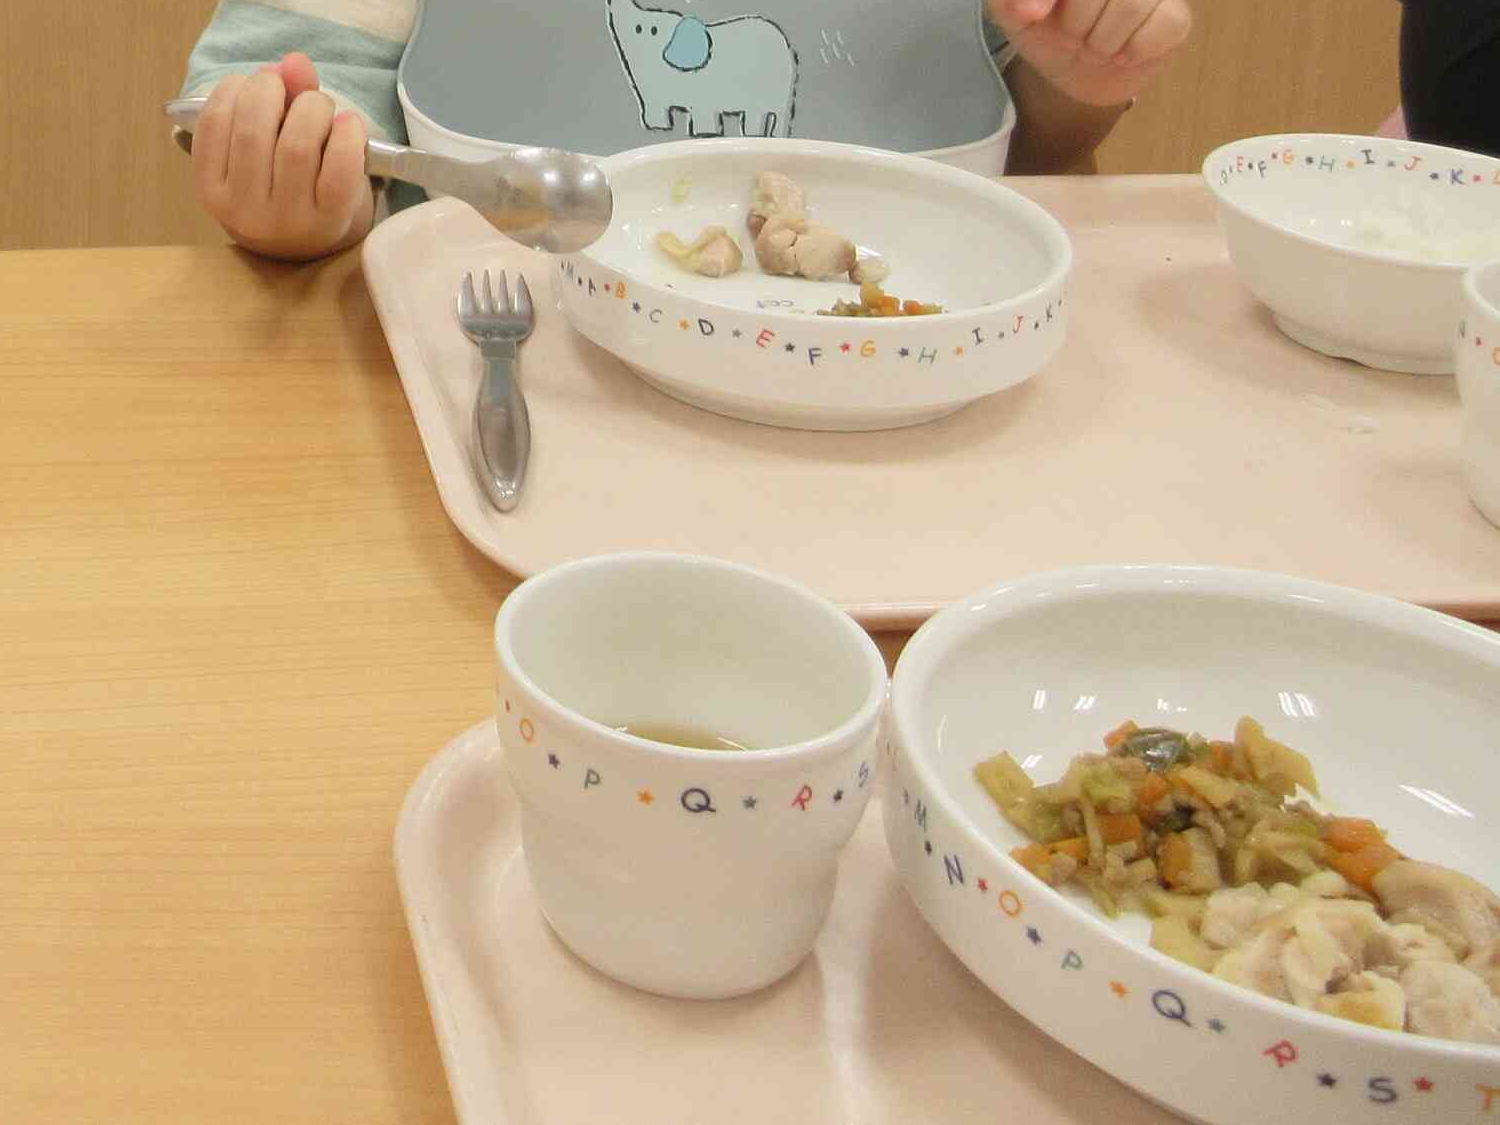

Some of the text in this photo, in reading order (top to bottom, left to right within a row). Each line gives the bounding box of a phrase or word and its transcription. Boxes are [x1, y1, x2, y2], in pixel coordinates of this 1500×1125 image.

[1257, 161, 1267, 178] F
[1318, 155, 1336, 172] H
[1361, 149, 1376, 165] I
[1404, 155, 1422, 171] J
[1451, 169, 1465, 186] K
[649, 308, 663, 323] C
[698, 318, 714, 336] D
[756, 329, 775, 347] E
[808, 347, 821, 365] F
[860, 340, 876, 358] G
[918, 346, 937, 364] H
[972, 327, 985, 346] I
[1012, 316, 1023, 333] J
[519, 718, 535, 743] O
[584, 769, 601, 790] P
[681, 787, 717, 813] Q
[791, 784, 813, 812] R
[943, 854, 964, 885] N
[999, 890, 1023, 918] O
[1061, 950, 1082, 970] P
[1151, 989, 1195, 1028] Q
[1263, 1040, 1299, 1068] R
[1368, 1077, 1397, 1104] S
[1475, 1083, 1500, 1110] T
